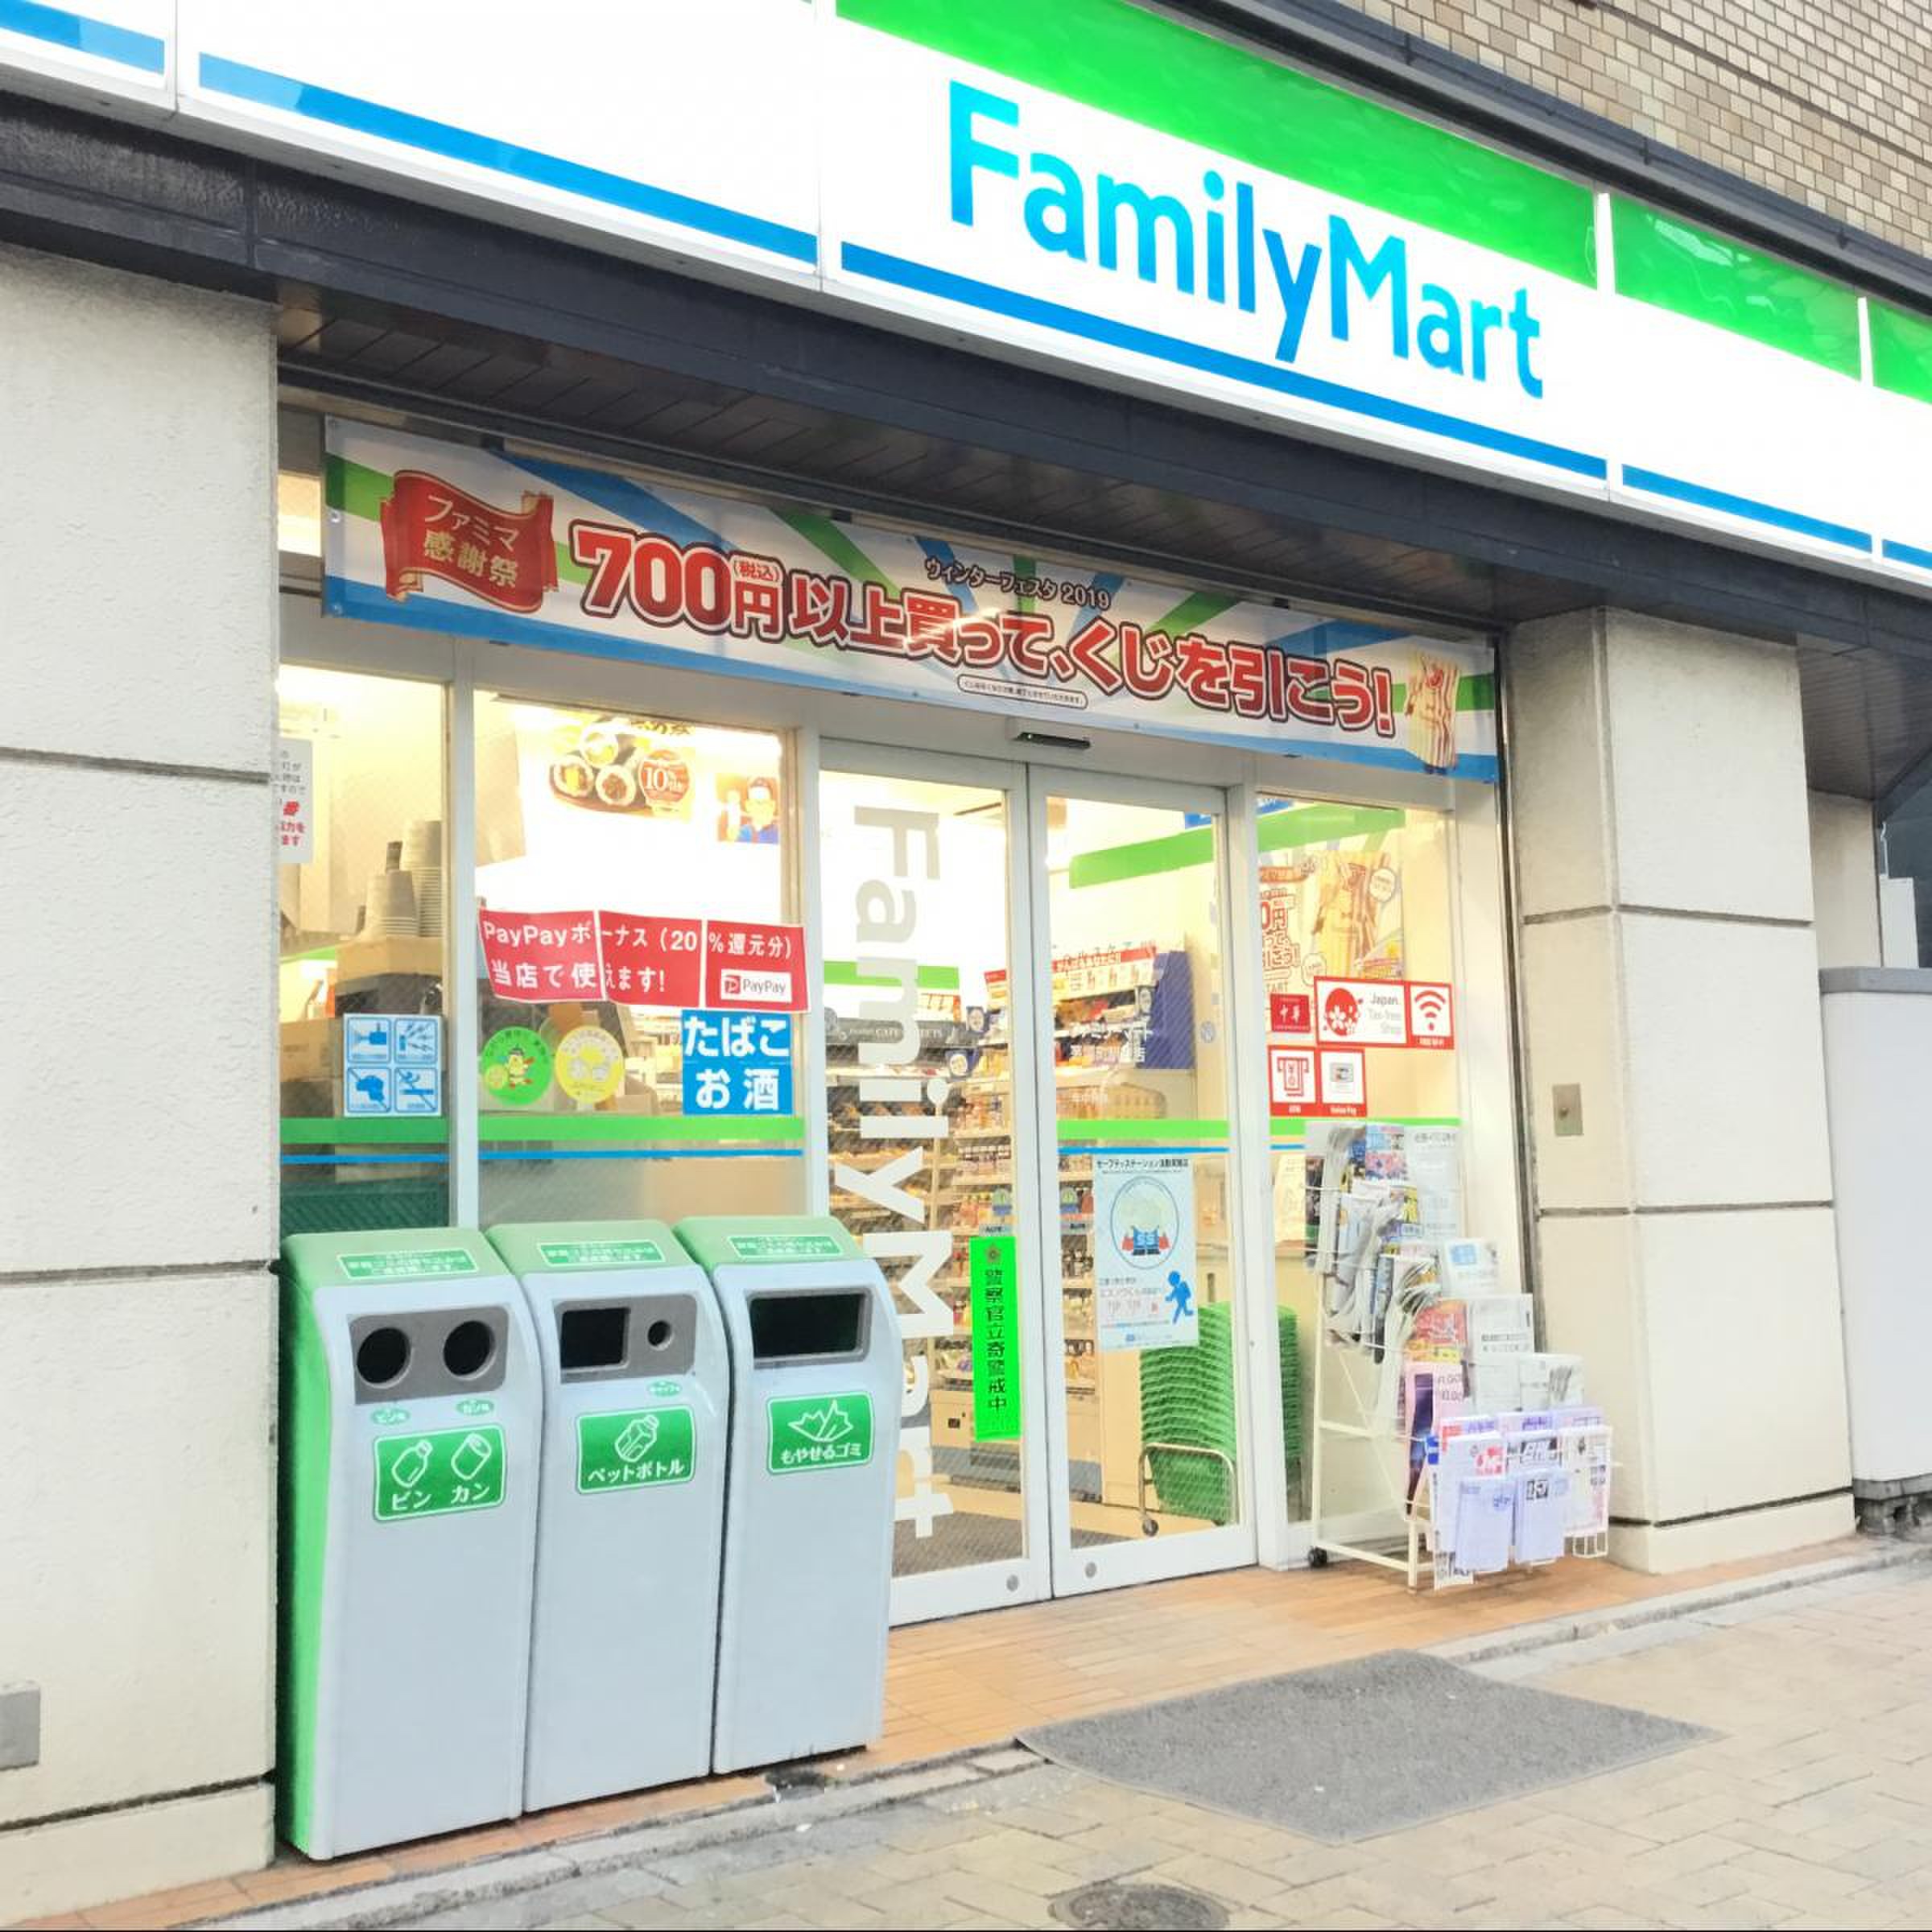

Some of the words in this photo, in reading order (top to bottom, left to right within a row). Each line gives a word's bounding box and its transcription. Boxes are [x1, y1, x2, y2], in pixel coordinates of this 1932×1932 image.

[949, 80, 1543, 399] FamilyMart
[424, 494, 520, 552] ファミマ
[424, 530, 518, 588] 感謝祭
[925, 558, 1058, 601] ウィンターフェスタ
[1061, 582, 1111, 611] 2019
[742, 978, 786, 995] PayPay
[1370, 991, 1399, 1007] Japan
[683, 1016, 791, 1057] たばこ
[696, 1068, 779, 1110] お酒
[587, 1458, 684, 1484] ペットボトル
[780, 1442, 862, 1465] もやせるゴミ
[391, 1490, 431, 1511] ビン
[450, 1482, 490, 1505] カン
